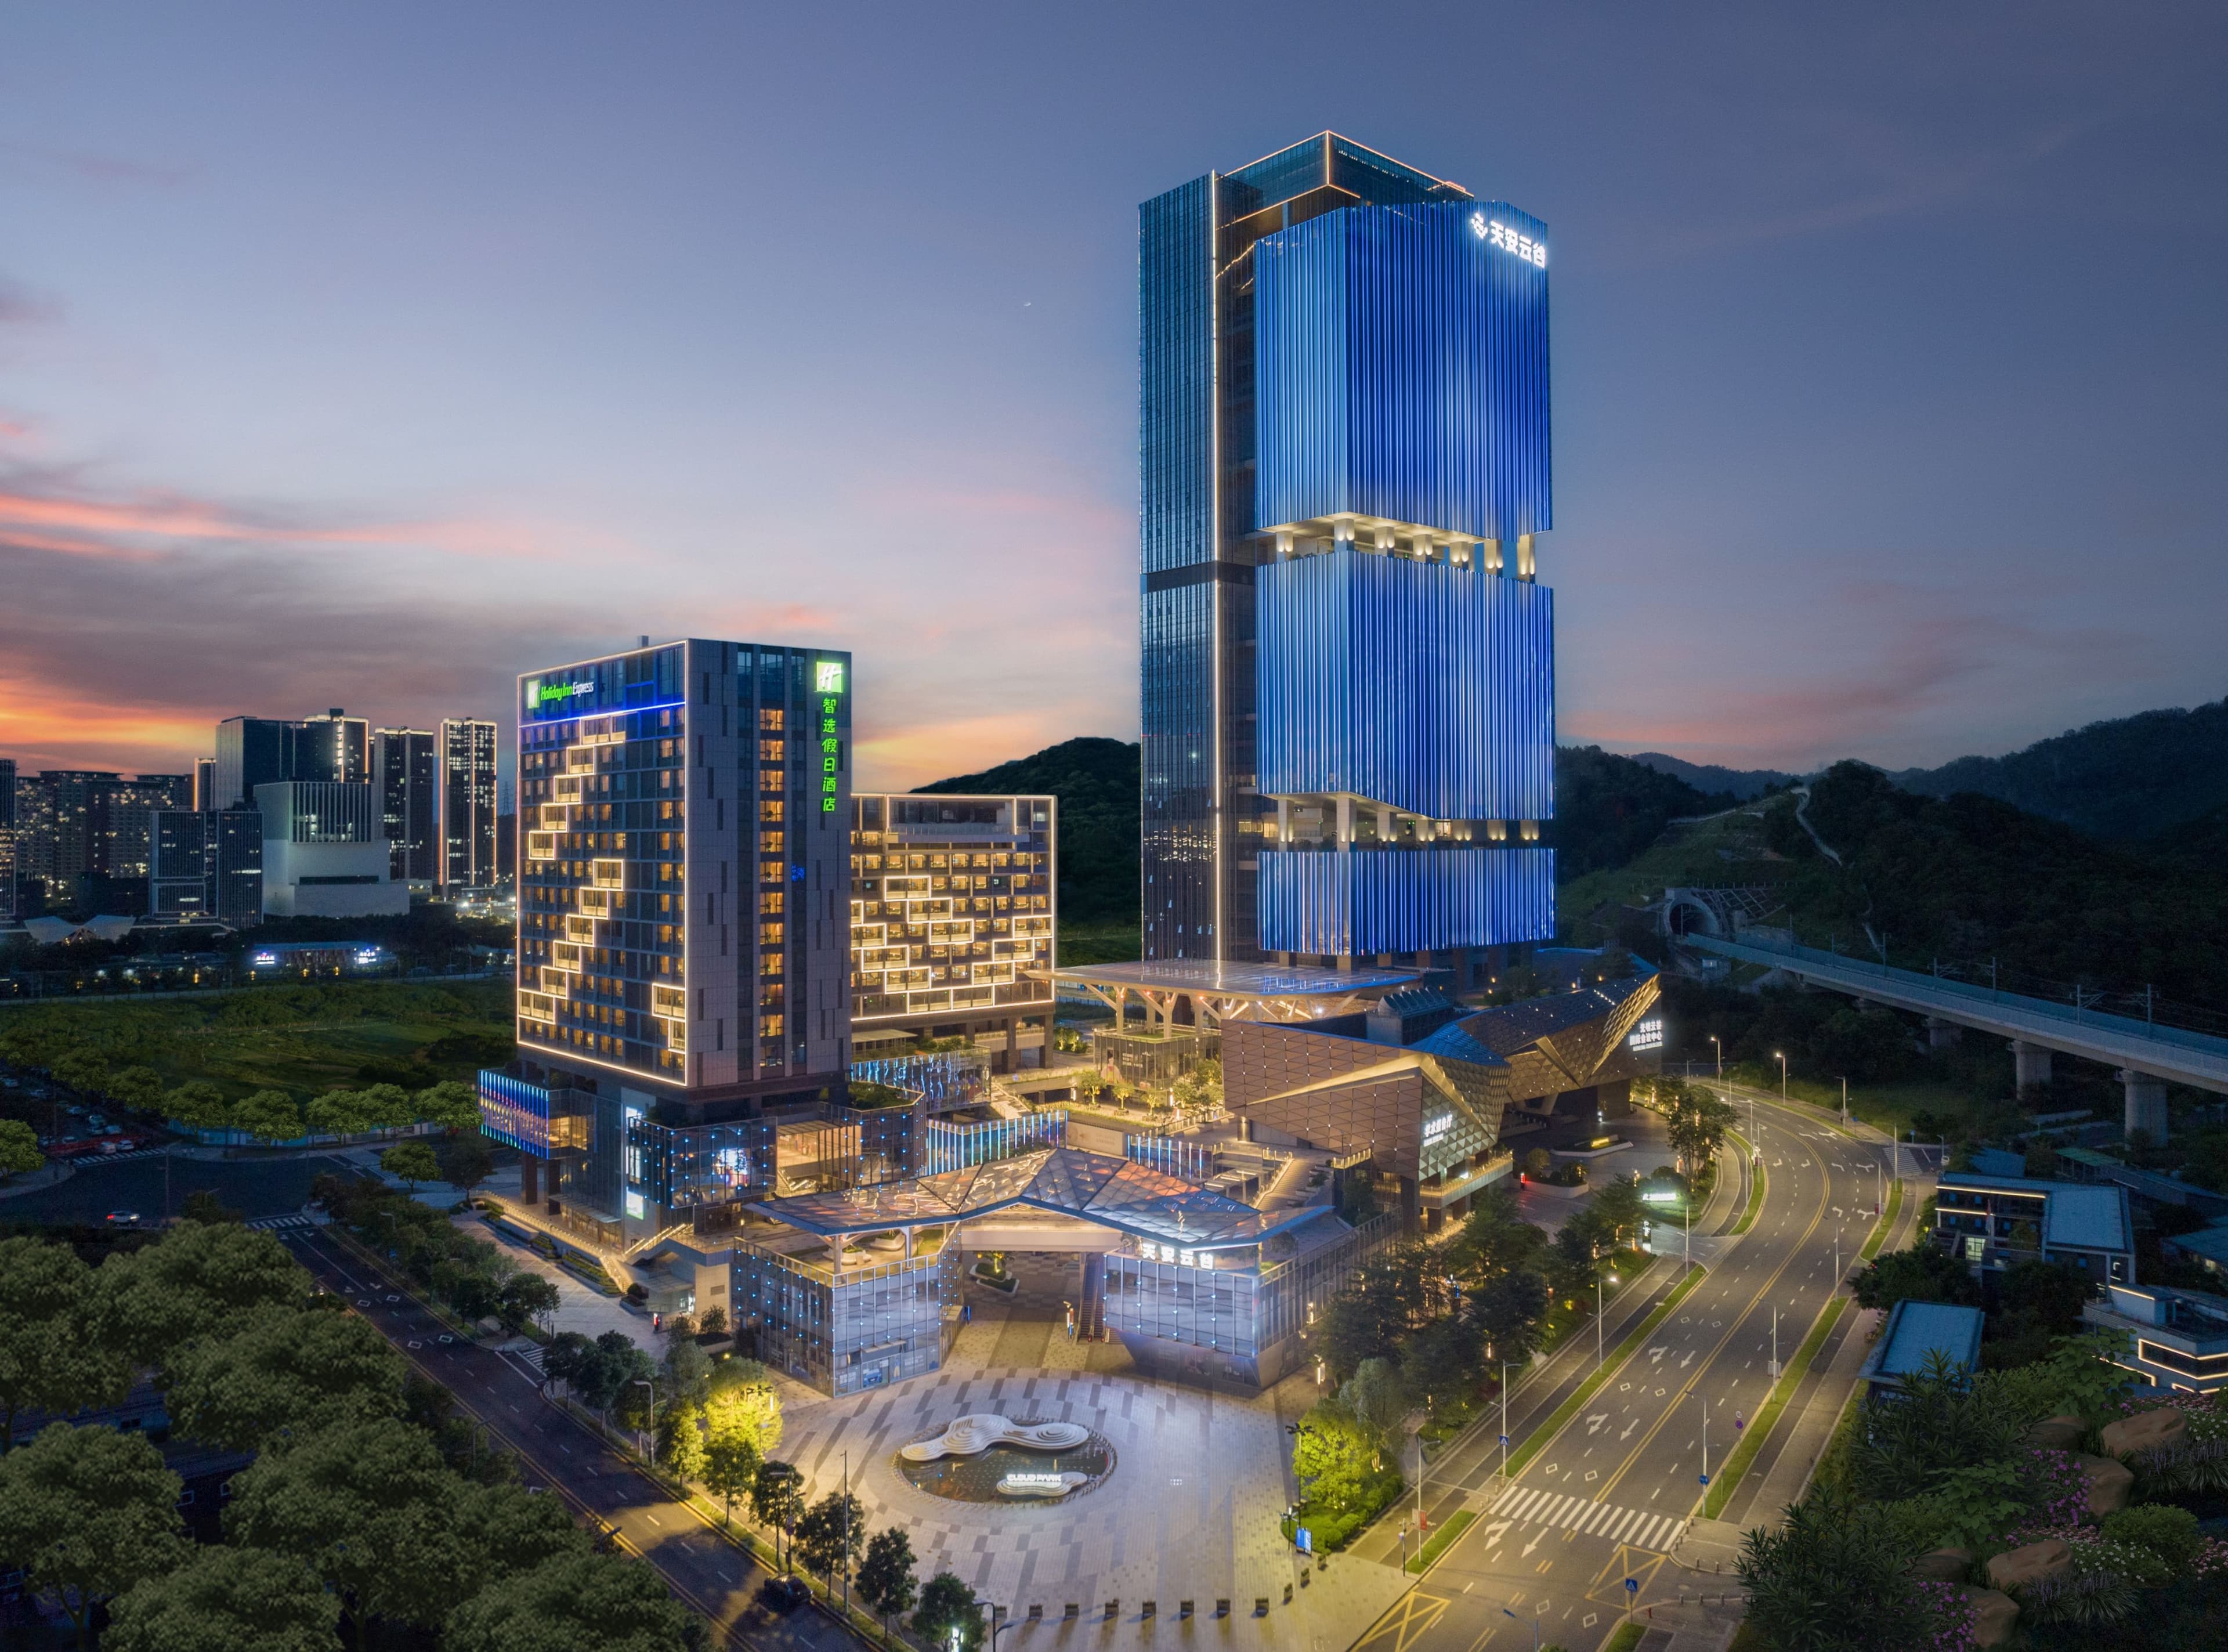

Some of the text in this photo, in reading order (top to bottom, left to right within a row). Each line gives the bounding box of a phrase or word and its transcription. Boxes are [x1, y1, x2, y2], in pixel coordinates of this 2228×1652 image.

[1491, 221, 1546, 268] 天安云谷
[541, 681, 594, 701] Holiday Inn Express
[822, 697, 837, 812] 智选假日酒店
[1142, 1243, 1214, 1270] 天安云谷
